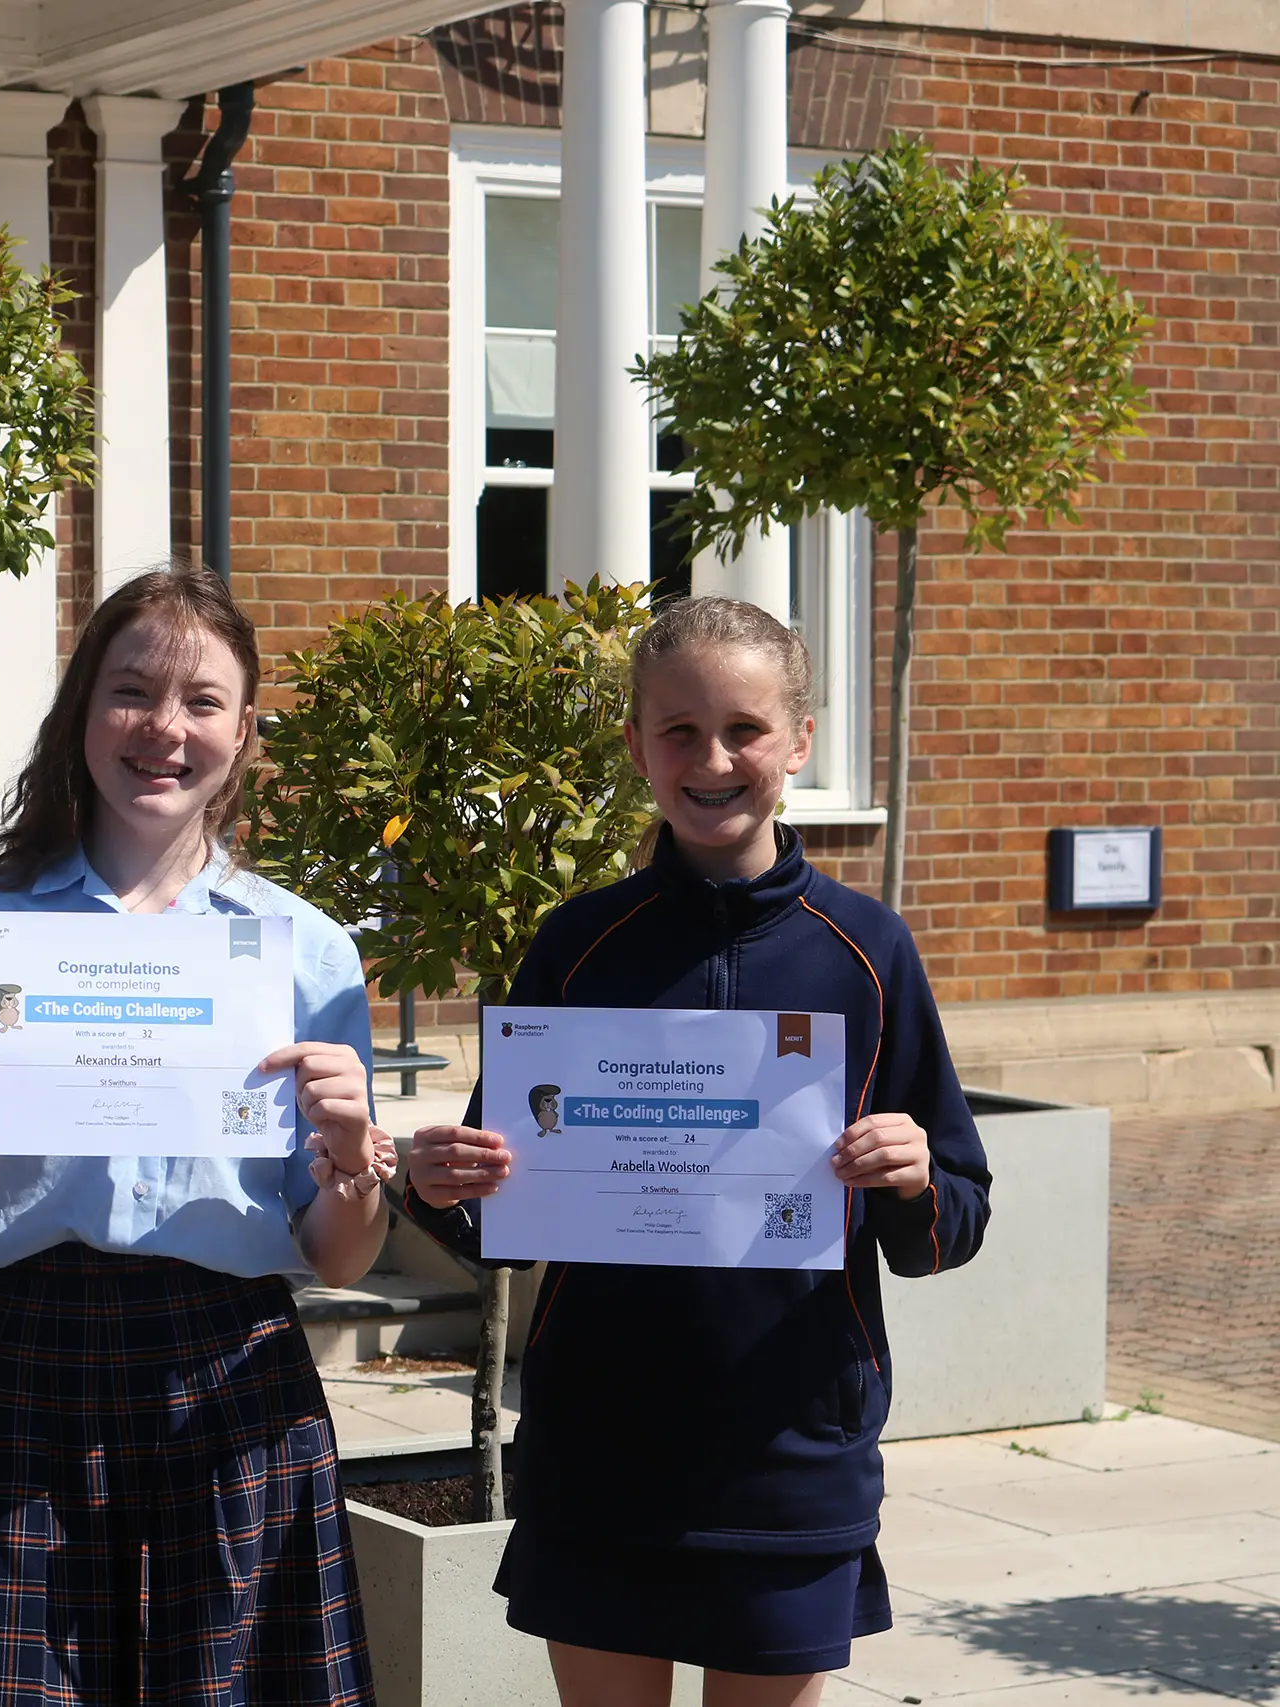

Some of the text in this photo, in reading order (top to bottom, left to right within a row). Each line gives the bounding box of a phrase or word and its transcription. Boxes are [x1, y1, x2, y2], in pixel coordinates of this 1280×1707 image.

[58, 960, 180, 977] Congratulations
[77, 979, 161, 993] on completing
[34, 1001, 203, 1020] <The Coding Challenge>
[142, 1029, 153, 1038] 32
[75, 1054, 162, 1066] Alexandra Smart
[597, 1059, 725, 1077] Congratulations
[108, 1079, 137, 1087] Swithuns
[618, 1079, 704, 1094] on completing
[573, 1104, 749, 1124] <The Coding Challenge>
[684, 1133, 696, 1143] 24
[610, 1160, 710, 1173] Arabella Woolston
[649, 1185, 679, 1193] Swithuns
